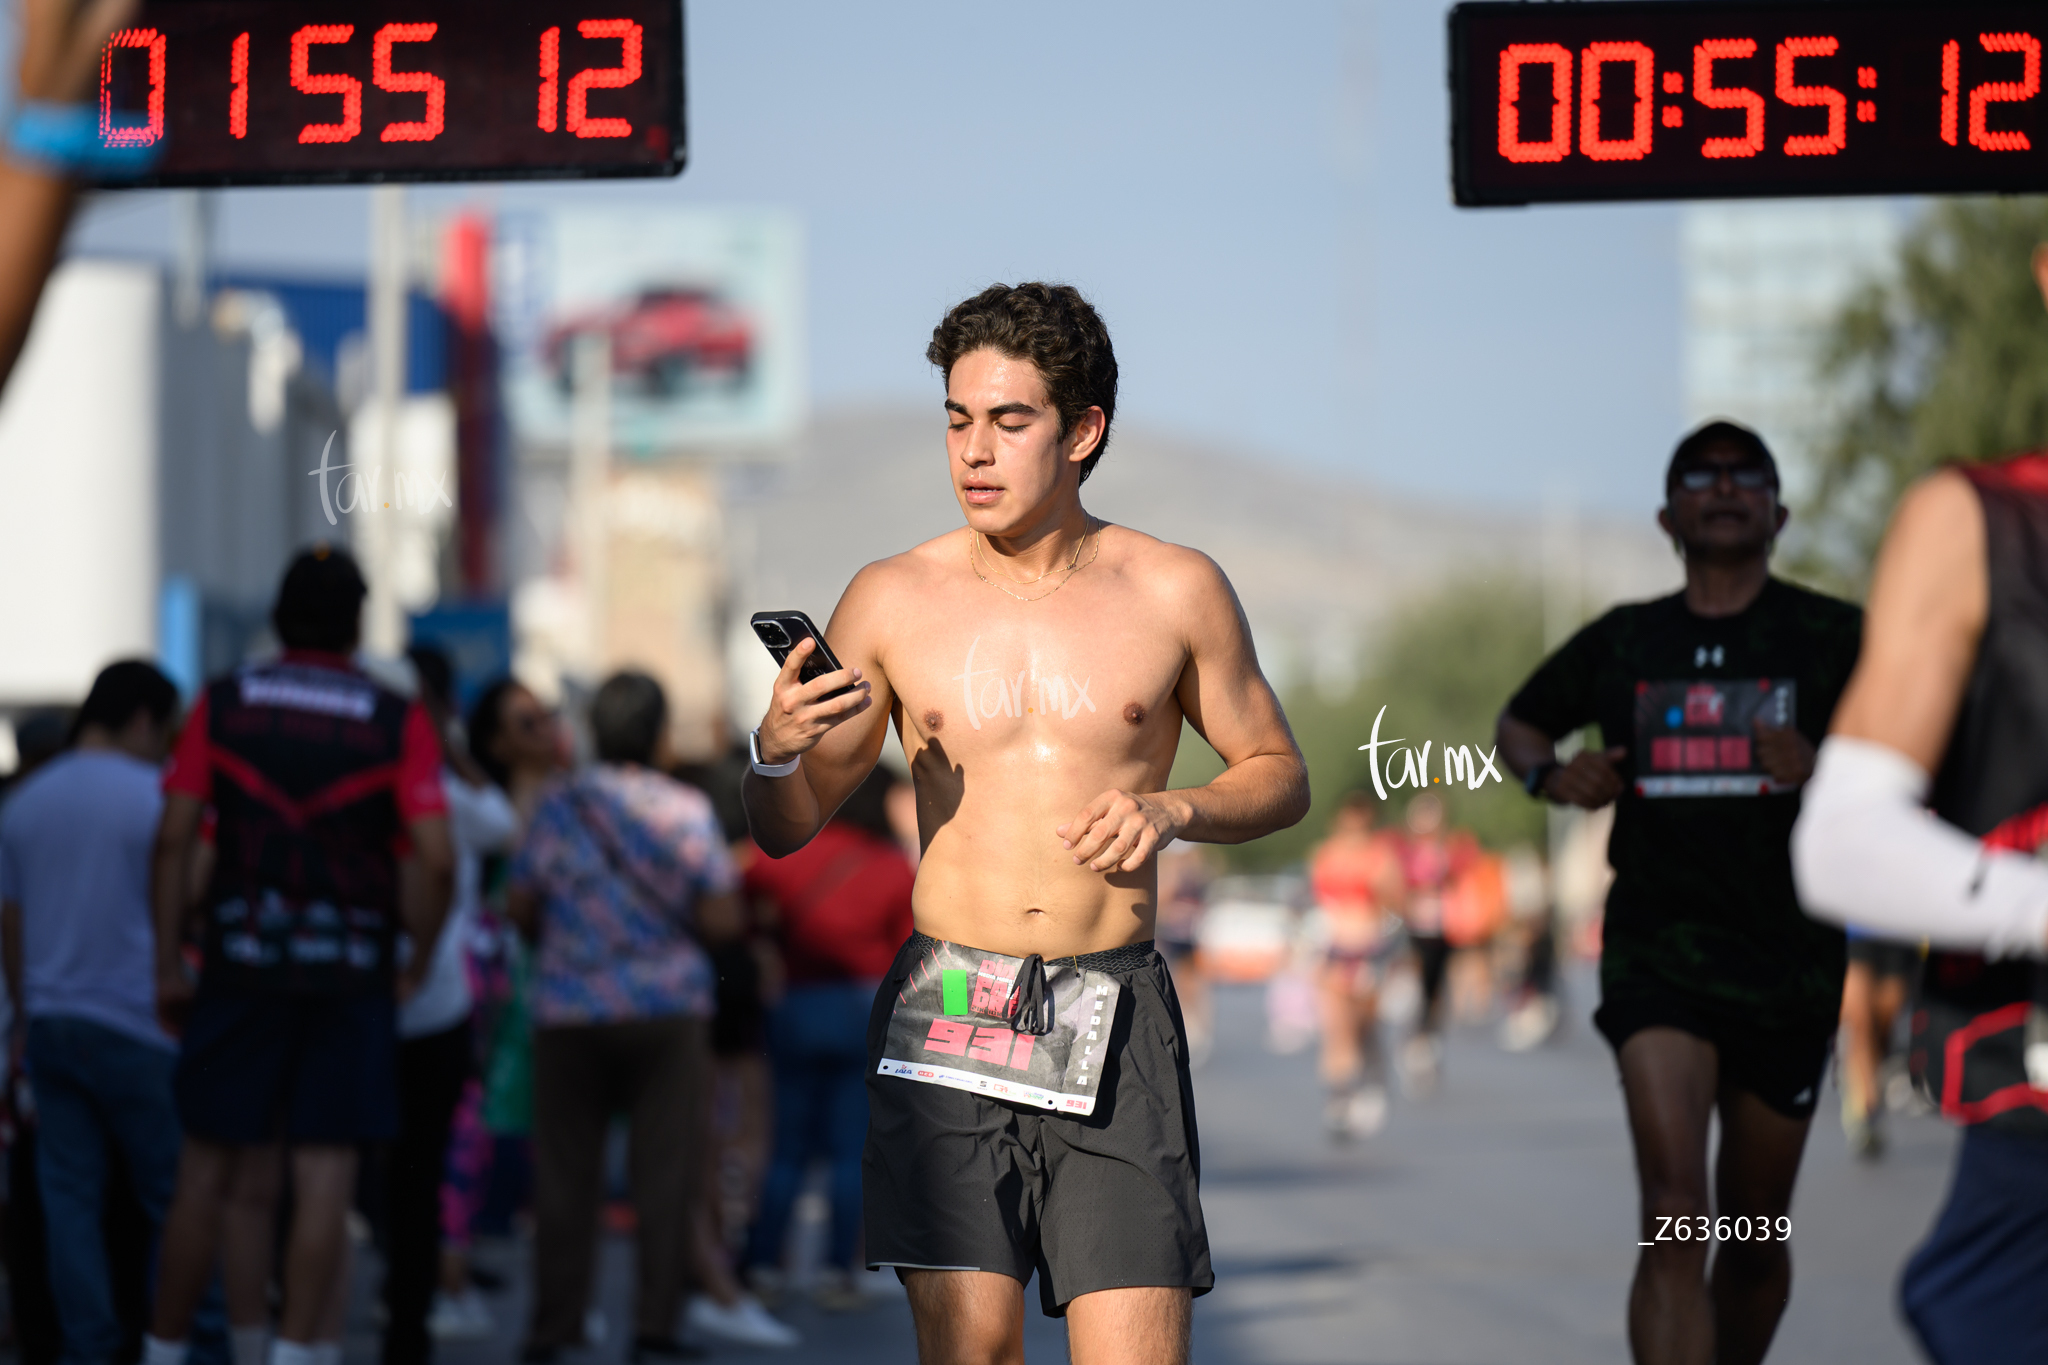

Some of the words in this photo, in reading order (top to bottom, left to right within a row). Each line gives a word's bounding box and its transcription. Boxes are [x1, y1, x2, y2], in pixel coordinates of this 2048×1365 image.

[537, 19, 643, 138] 12
[923, 1018, 1035, 1071] 931
[1076, 985, 1108, 1085] MEDALLA
[1066, 1099, 1087, 1110] 931
